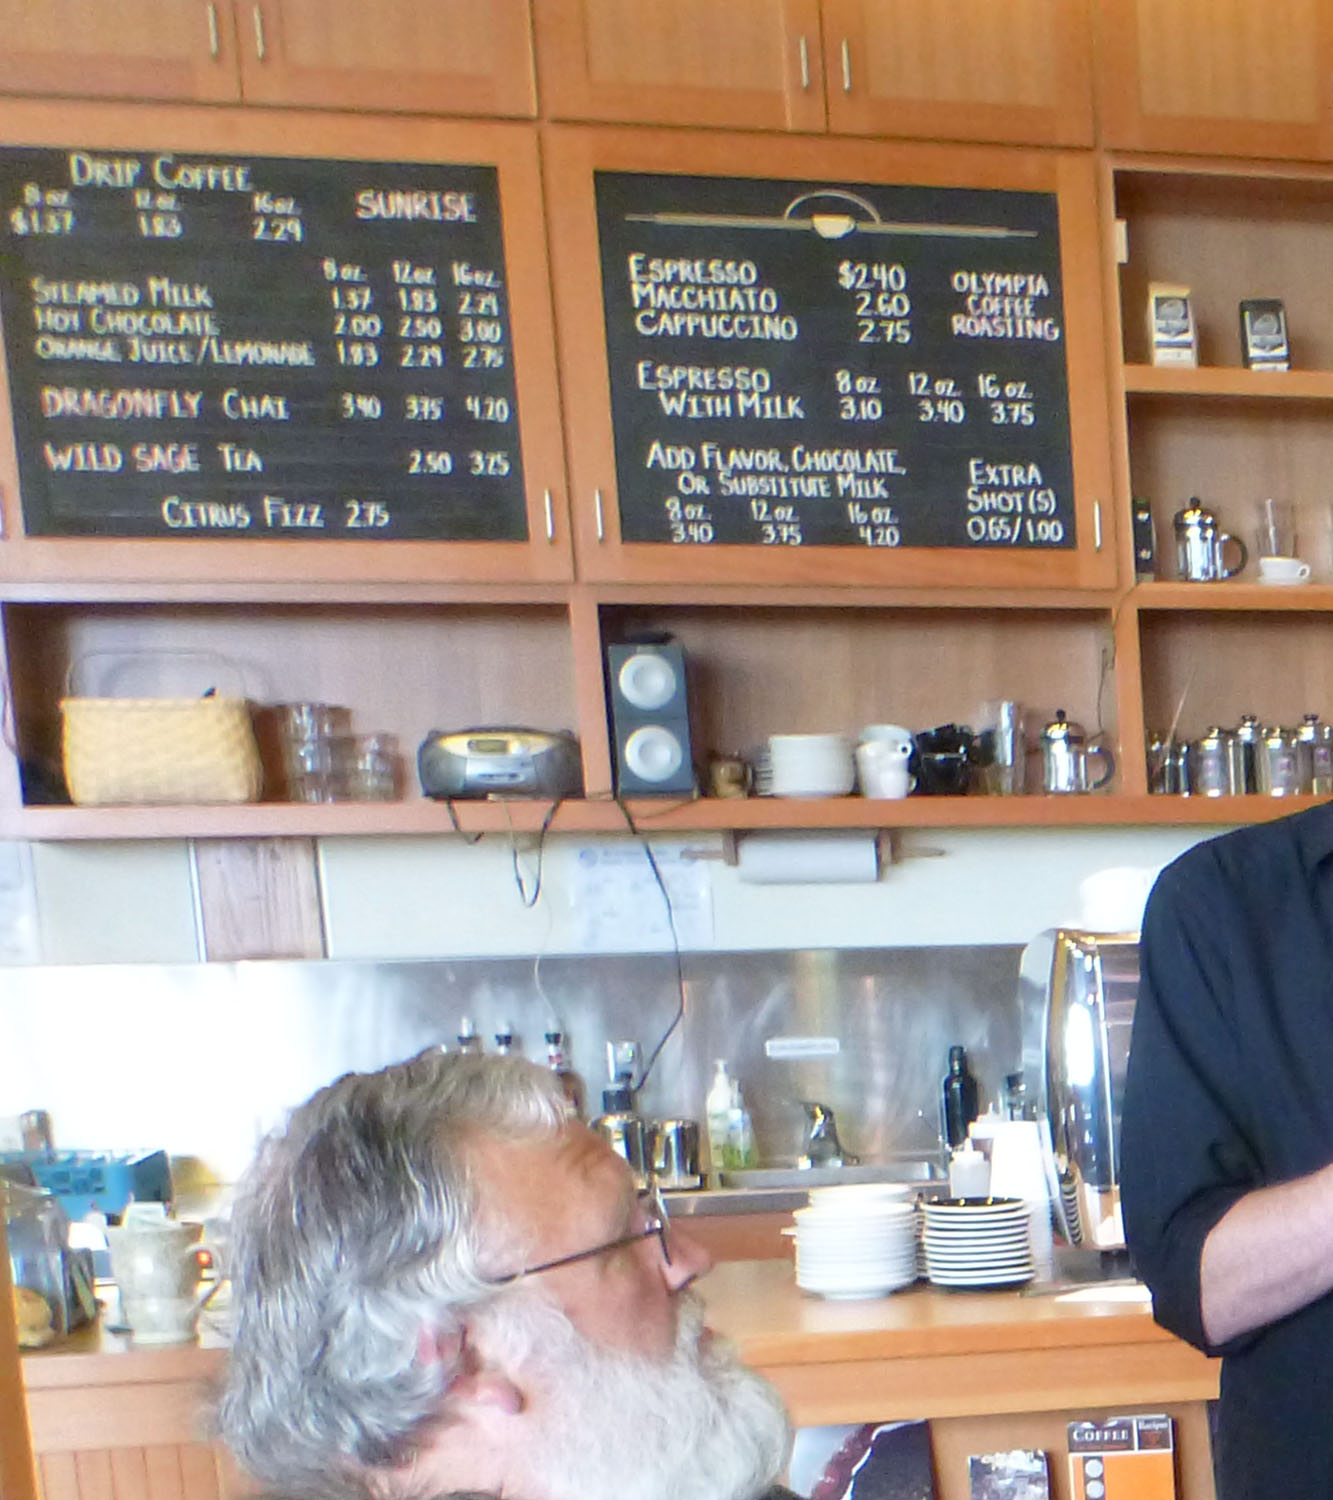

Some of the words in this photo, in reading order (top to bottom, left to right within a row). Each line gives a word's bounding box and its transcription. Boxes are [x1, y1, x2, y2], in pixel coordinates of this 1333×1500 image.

[69, 152, 140, 187] DRIP
[152, 152, 252, 192] COFFEE
[356, 189, 478, 222] SUNRISE
[629, 252, 757, 285] ESPRESSO
[838, 260, 907, 291] $2.40
[952, 271, 1050, 296] OLYMPIA
[31, 275, 140, 306] STEAMED
[148, 276, 214, 308] MILK
[631, 282, 778, 313] MACCHIATO
[855, 291, 911, 317] 2.60
[967, 295, 1035, 318] COFFEE
[33, 306, 80, 332] HOT
[90, 306, 221, 336] CHOCOLATE
[333, 312, 381, 337] 2.00
[635, 309, 798, 341] CAPPUCCINO
[858, 319, 912, 344] 2.75
[952, 313, 1061, 342] ROASTING
[35, 336, 122, 362] ORANGE
[637, 360, 770, 393] ESPRESSO
[41, 385, 203, 420] DRAGONFLY
[222, 387, 291, 421] CHAI
[657, 389, 732, 418] WITH
[737, 391, 806, 419] MILK
[840, 396, 882, 421] 3.10
[919, 400, 965, 423] 3.40
[991, 402, 1035, 426] 3.75
[43, 443, 123, 473] WILD
[133, 442, 200, 474] SAGE
[217, 442, 263, 472] TEA
[646, 439, 695, 470] ADD
[678, 471, 711, 495] OR
[718, 471, 831, 498] SUBSTITUTE
[837, 473, 889, 499] MILK
[969, 457, 1042, 487] EXTRA
[161, 496, 251, 528] CITRUS
[263, 495, 325, 528] FIZZ
[670, 522, 714, 543] 3.40
[762, 523, 802, 545] 3.75
[859, 526, 900, 547] 4.20
[1073, 1429, 1129, 1441] COFFEE
